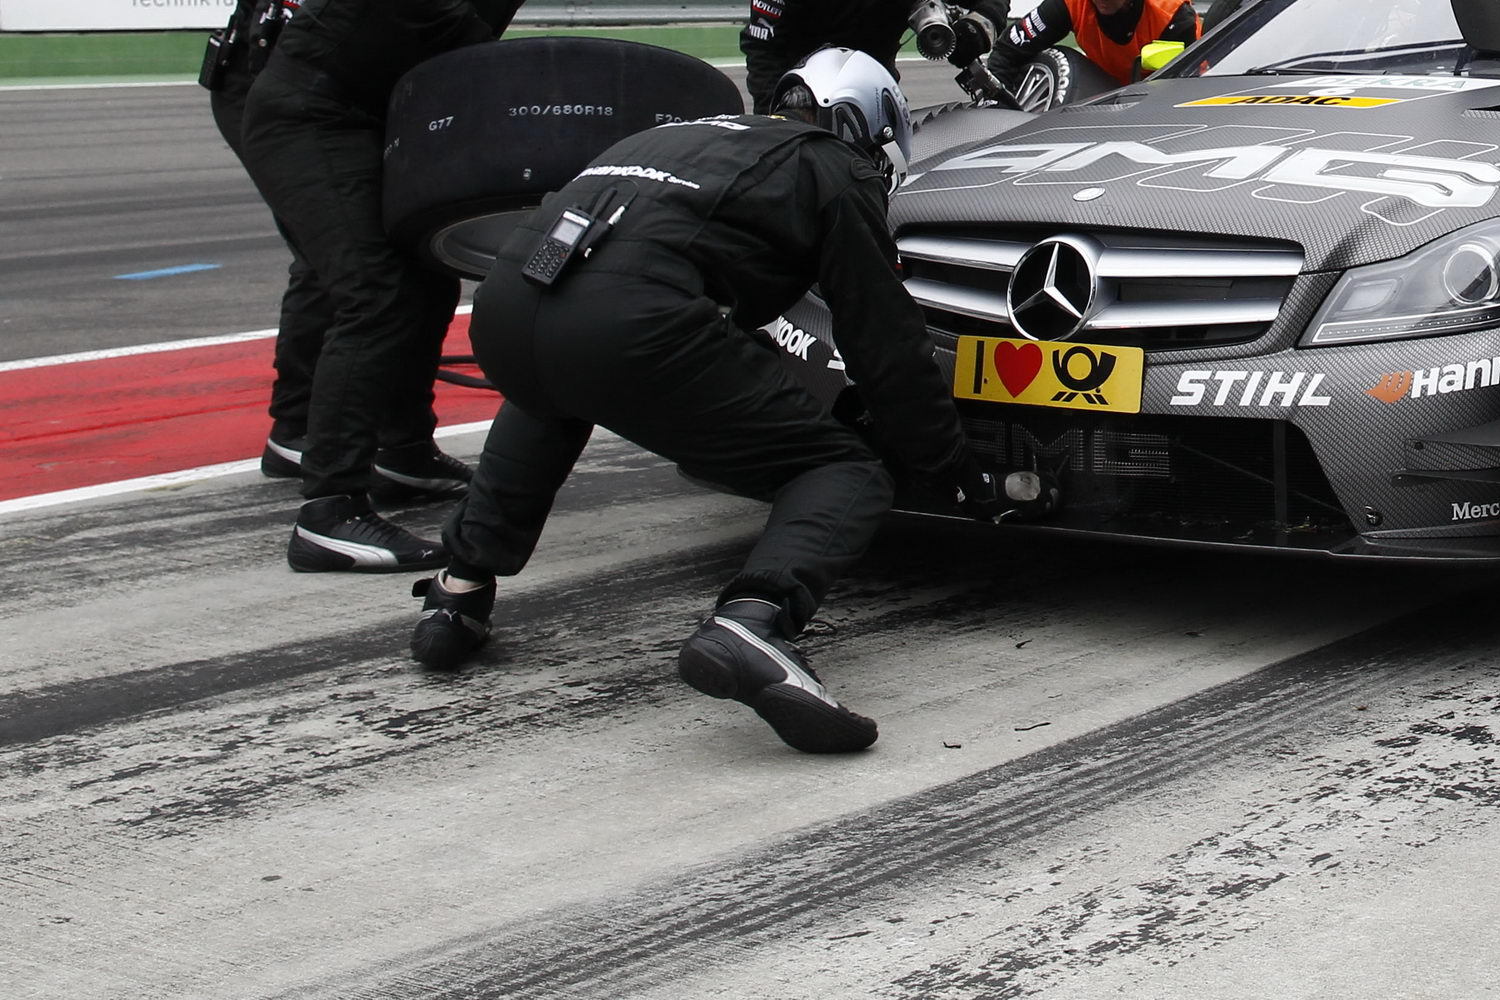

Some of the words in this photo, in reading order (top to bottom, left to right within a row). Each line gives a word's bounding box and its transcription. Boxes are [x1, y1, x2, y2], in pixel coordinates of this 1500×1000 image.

[1307, 76, 1467, 89] DEKRA
[1228, 95, 1352, 107] ADAC
[508, 104, 614, 117] 300/680R18
[428, 116, 455, 132] G77
[1169, 370, 1332, 408] STIHL
